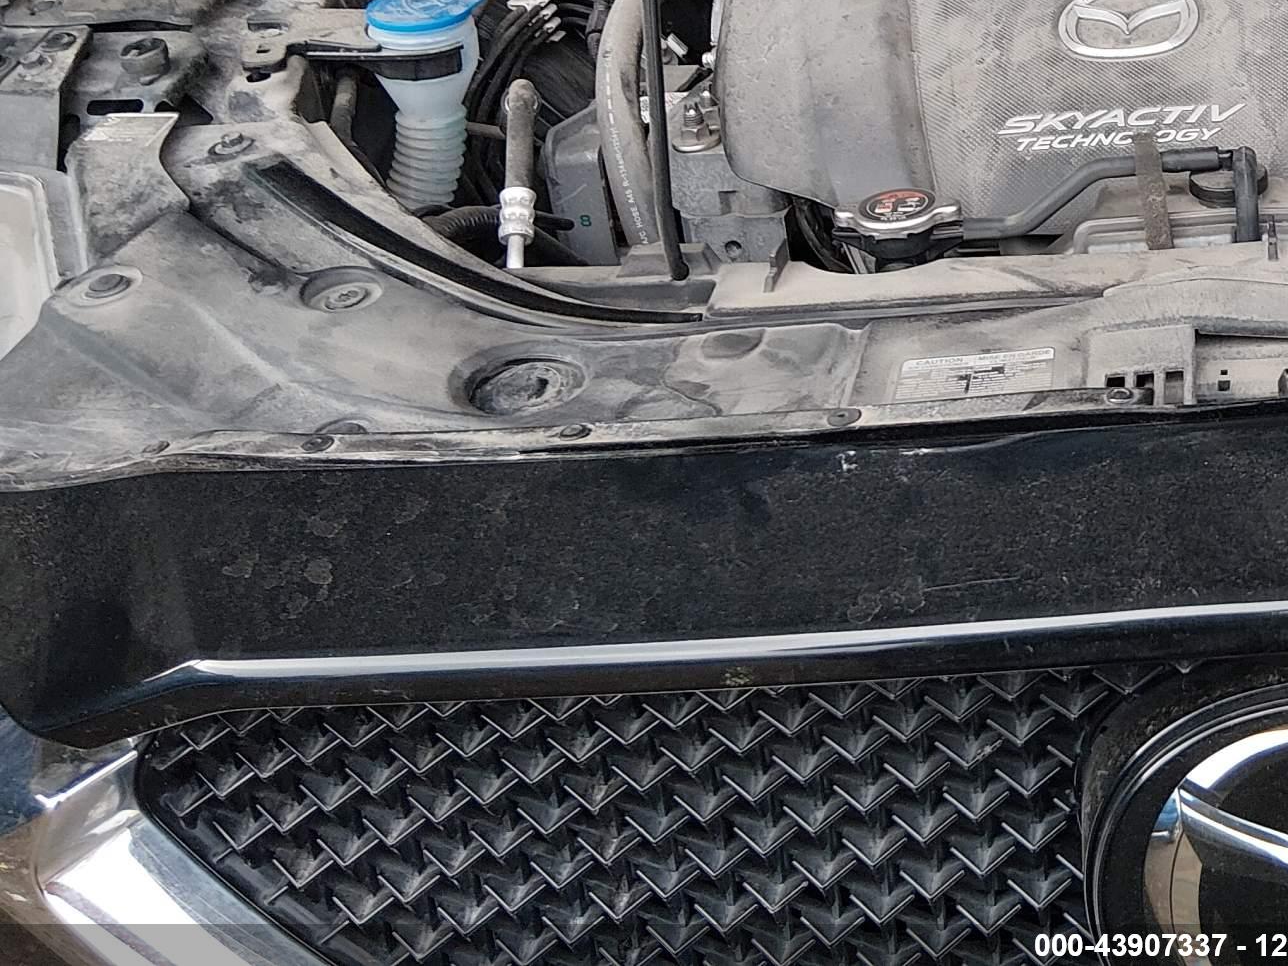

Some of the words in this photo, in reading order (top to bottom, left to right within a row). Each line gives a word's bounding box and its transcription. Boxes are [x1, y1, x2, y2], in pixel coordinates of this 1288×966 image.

[998, 103, 1246, 135] SKYACTIV
[1017, 127, 1222, 152] TECHNOOGY
[630, 206, 643, 228] HOSE
[916, 357, 963, 366] CAUTION
